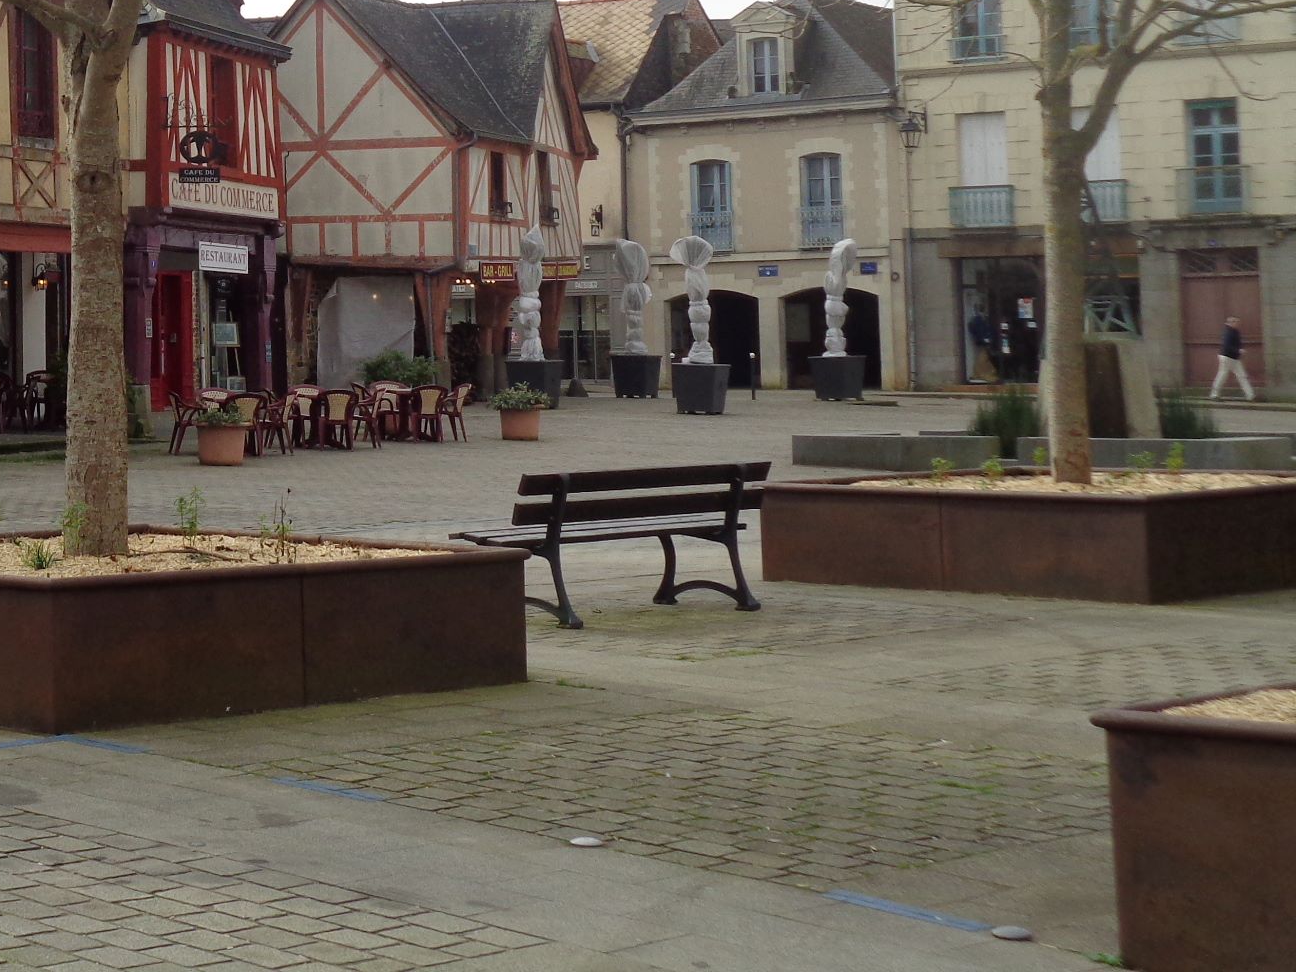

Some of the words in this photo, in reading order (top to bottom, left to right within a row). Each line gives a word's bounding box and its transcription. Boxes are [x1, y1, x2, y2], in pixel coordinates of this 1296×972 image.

[205, 184, 218, 204] DU
[220, 187, 274, 212] COMMERCE
[200, 249, 247, 265] RESTAURANT
[483, 265, 494, 277] BAR
[497, 265, 513, 277] GRILL
